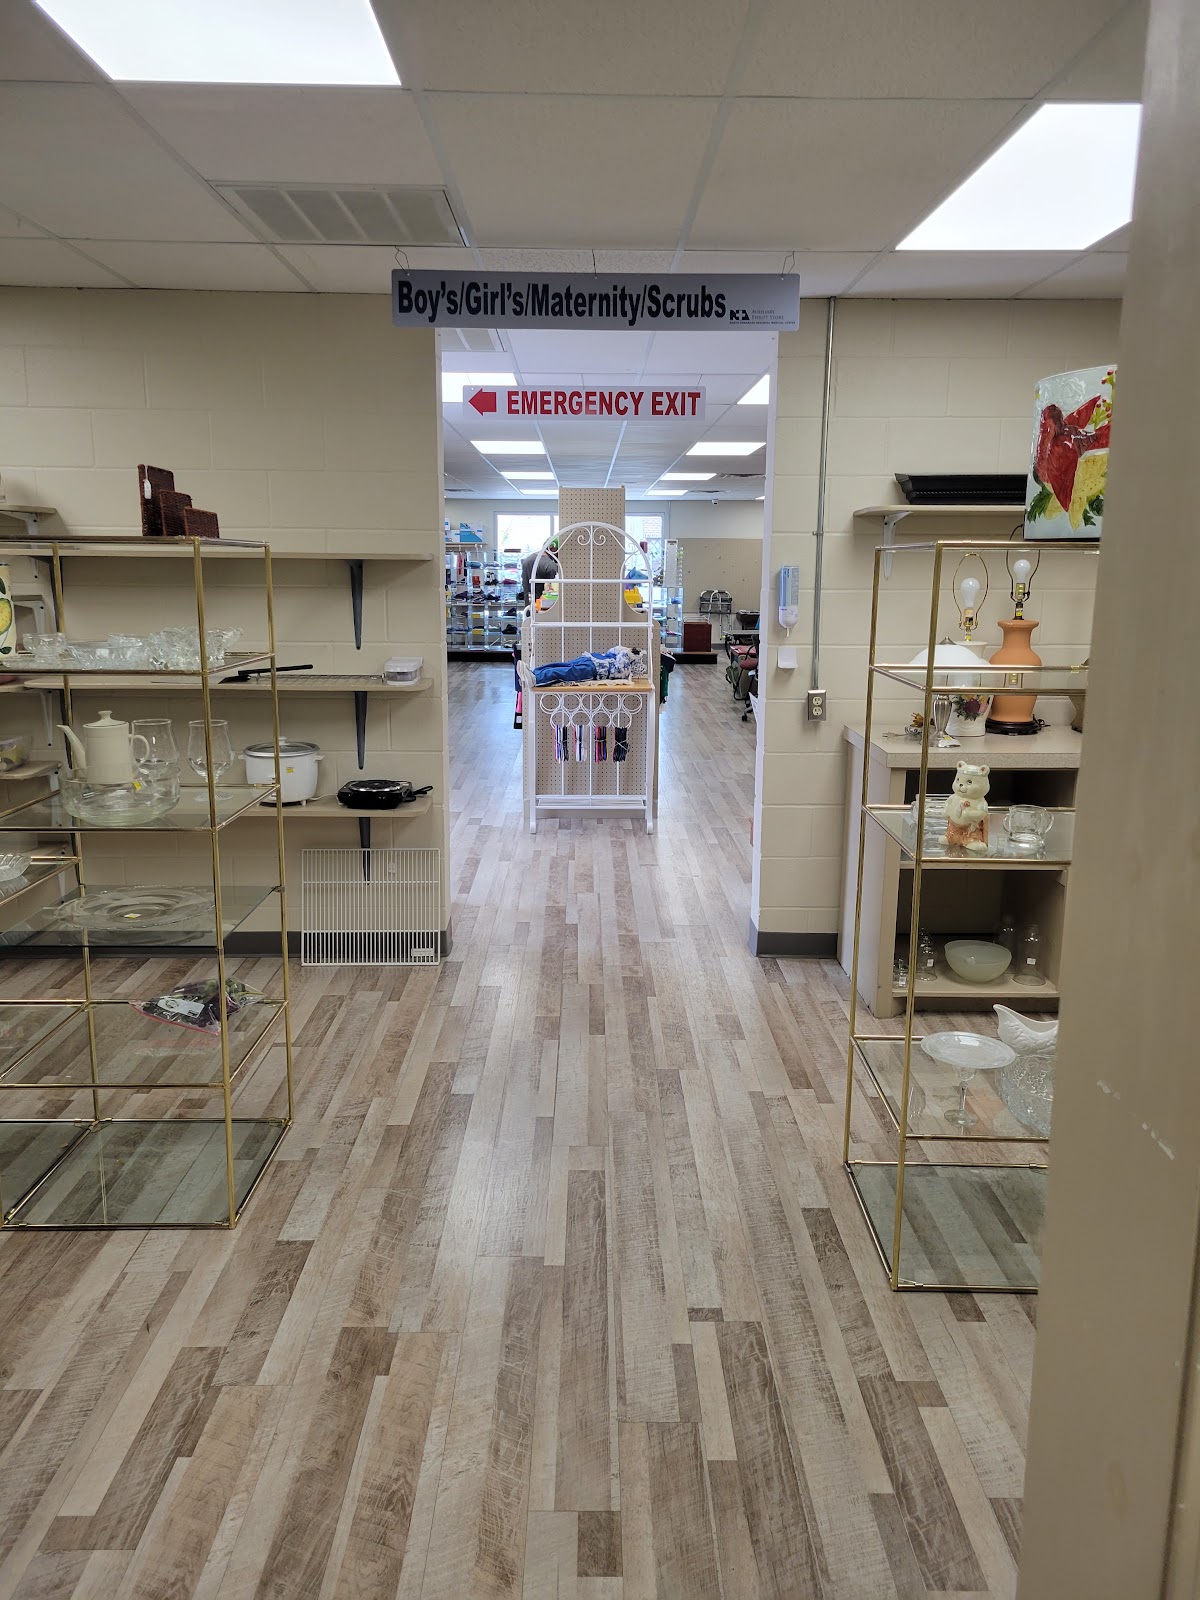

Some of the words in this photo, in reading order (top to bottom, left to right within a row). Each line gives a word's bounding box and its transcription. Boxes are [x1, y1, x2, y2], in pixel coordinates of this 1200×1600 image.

[397, 280, 727, 326] Boy's/Girl's/Maternity/Scrubs
[507, 391, 644, 416] EMERGENCY
[651, 391, 701, 416] EXIT
